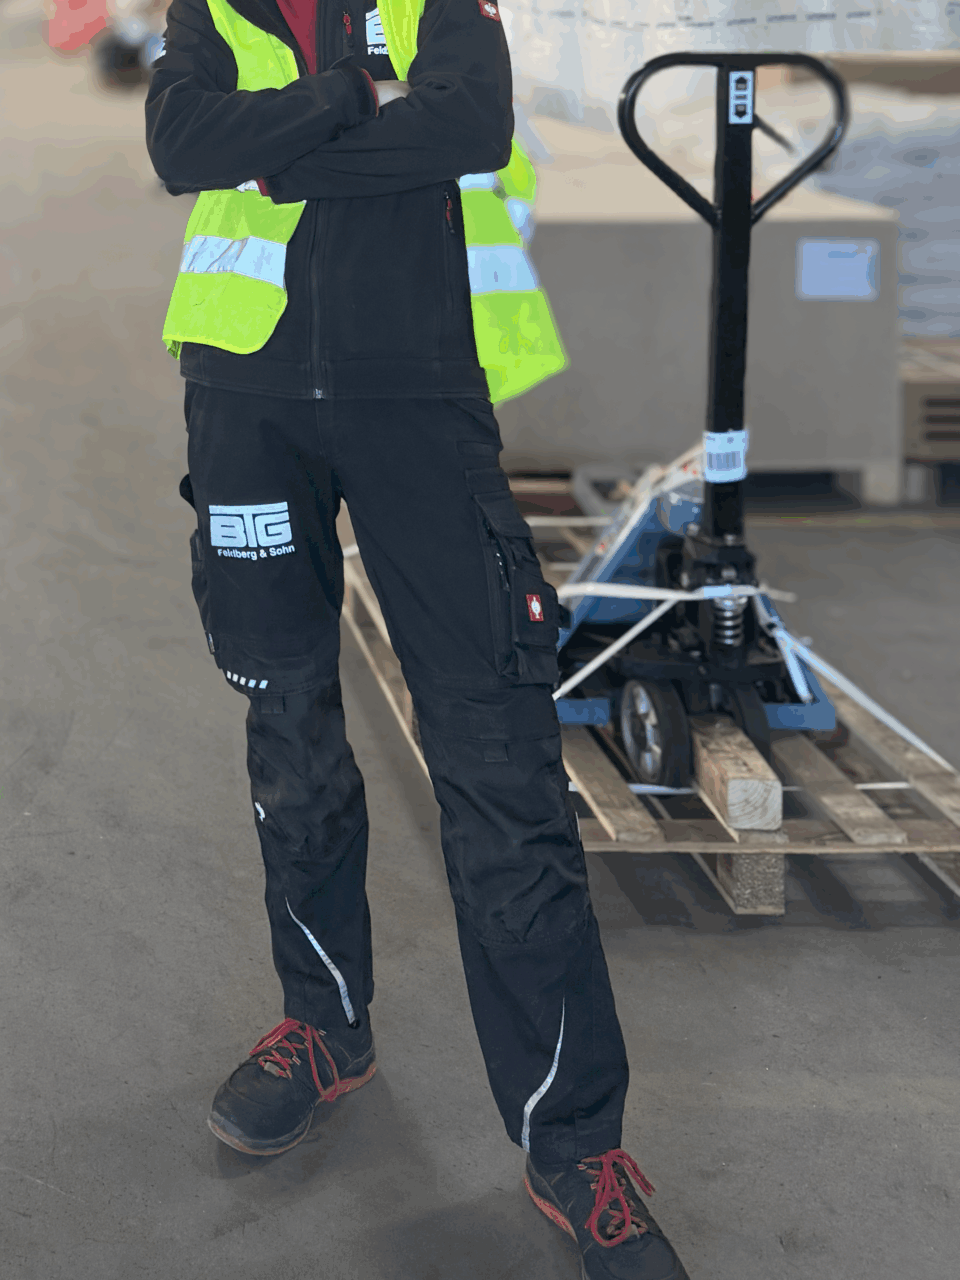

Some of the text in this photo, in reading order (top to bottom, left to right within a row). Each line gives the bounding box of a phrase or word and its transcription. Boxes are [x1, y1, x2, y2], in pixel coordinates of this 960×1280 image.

[208, 501, 292, 548] BTG
[217, 544, 296, 561] Feldberg & Sohn
